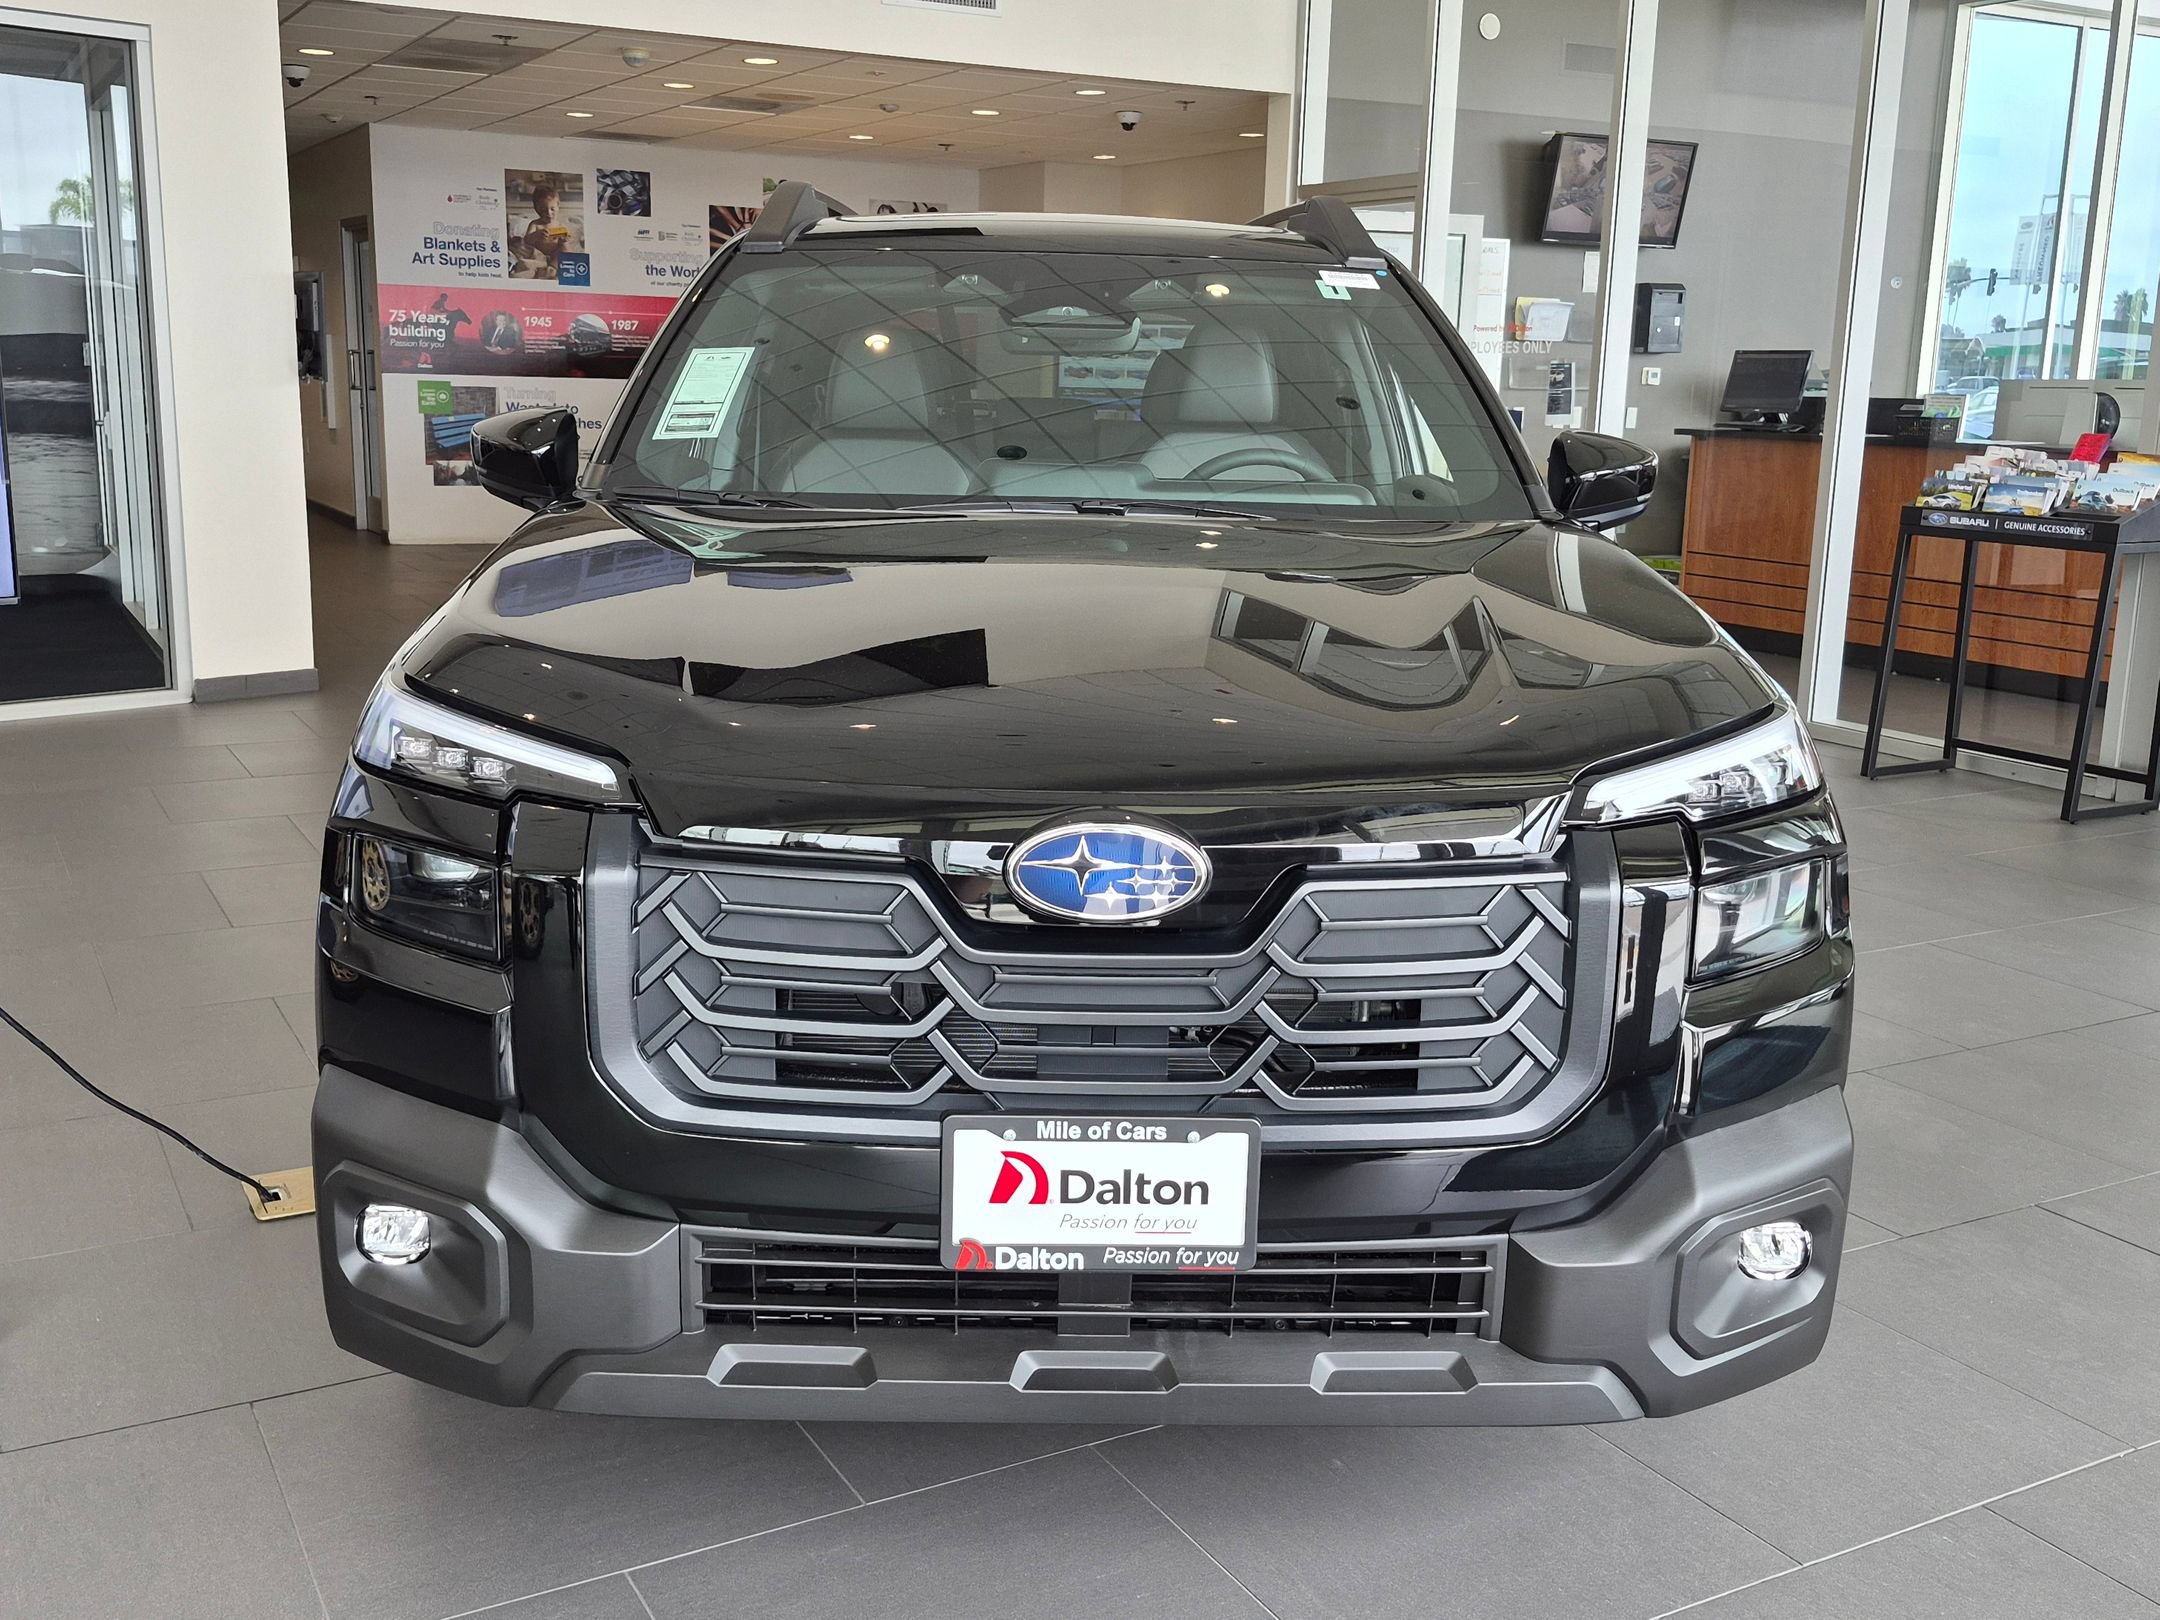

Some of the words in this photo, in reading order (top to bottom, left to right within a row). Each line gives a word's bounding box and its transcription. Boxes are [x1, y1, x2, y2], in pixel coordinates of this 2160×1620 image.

[433, 221, 499, 240] Donating
[423, 236, 486, 252] Blankets
[490, 240, 501, 253] &
[412, 251, 435, 265] Art
[438, 252, 501, 269] Supplies
[629, 248, 704, 266] Supporting
[645, 264, 667, 277] the
[388, 309, 406, 322] 75
[410, 310, 450, 326] Years,
[524, 316, 552, 328] 1945
[611, 319, 639, 331] 1987
[389, 324, 446, 342] building
[1473, 324, 1497, 332] Powered
[390, 339, 417, 348] Passion
[419, 340, 430, 348] for
[430, 341, 445, 350] you
[1468, 340, 1520, 354] PLOYEES
[1522, 341, 1553, 354] ONLY
[1949, 516, 1989, 528] SUBARU
[2004, 520, 2037, 532] GENUINE
[2037, 523, 2086, 536] ACCESSORIES
[1036, 1121, 1082, 1140] Mile
[1088, 1121, 1110, 1140] of
[1116, 1121, 1168, 1141] Cars
[1059, 1169, 1210, 1206] Dalton
[1059, 1213, 1128, 1230] Passion
[1134, 1213, 1160, 1230] for
[1162, 1217, 1198, 1231] you
[995, 1247, 1084, 1271] Dalton
[1102, 1247, 1170, 1265] Passion
[1176, 1248, 1203, 1266] for
[1203, 1251, 1240, 1267] you
